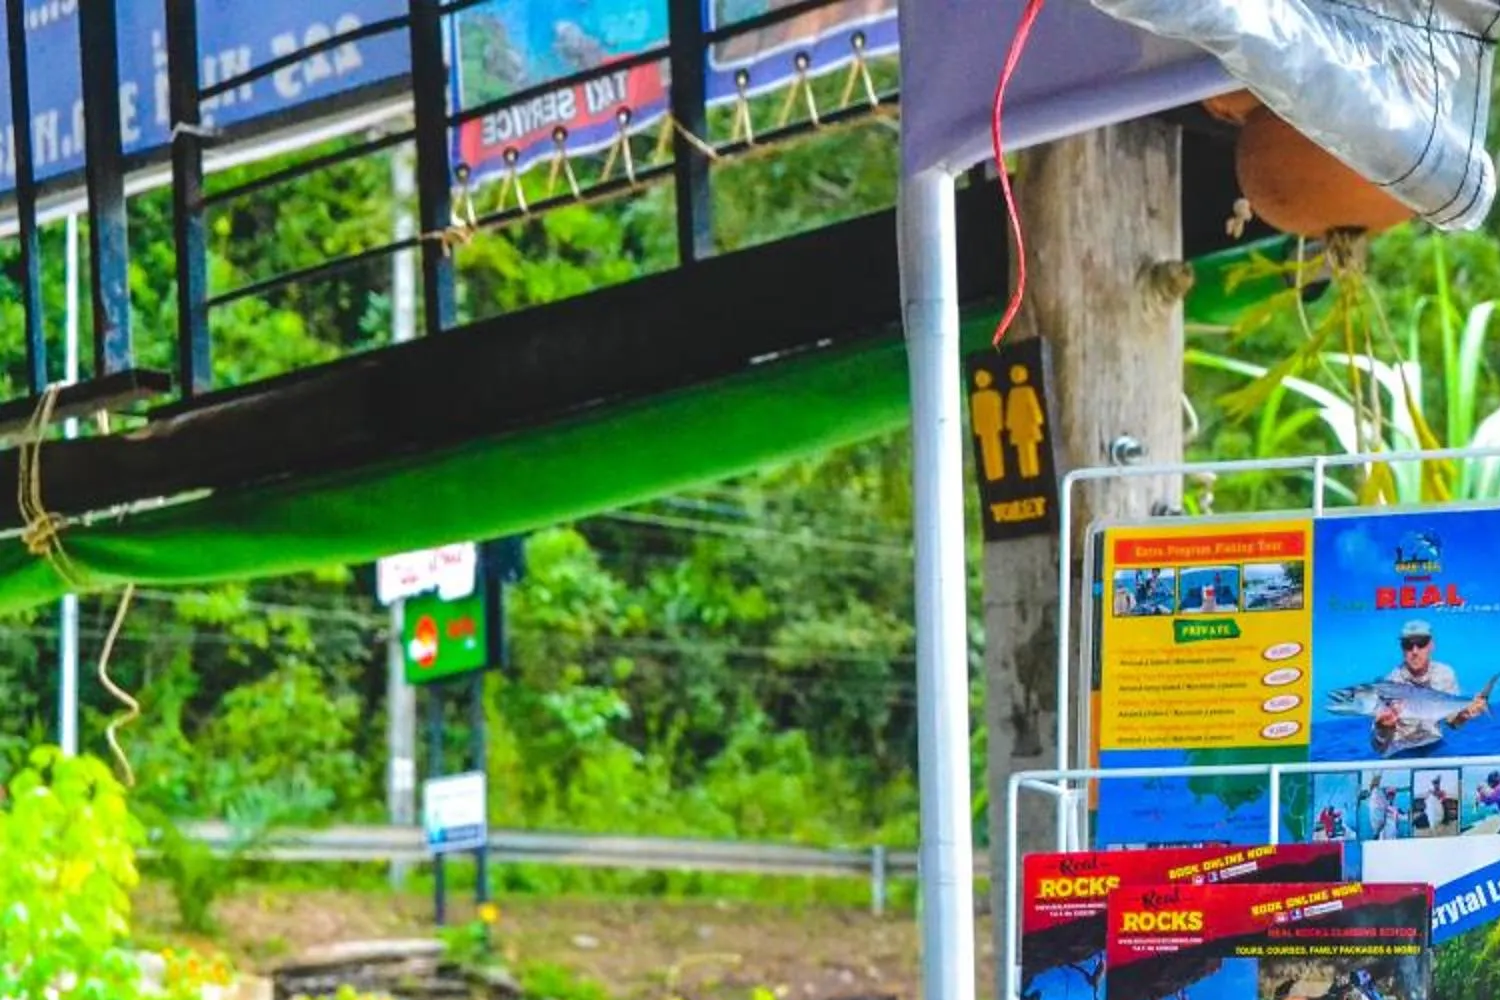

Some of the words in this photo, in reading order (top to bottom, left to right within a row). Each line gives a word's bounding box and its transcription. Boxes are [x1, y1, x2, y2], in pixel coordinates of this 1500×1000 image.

[1374, 583, 1465, 611] REAL
[1181, 623, 1231, 637] PRIVATE
[1168, 864, 1200, 880] BOOK
[1203, 853, 1245, 871] ONLINE
[1247, 844, 1277, 861] NOW!
[1251, 901, 1283, 917] BOOK
[1286, 891, 1329, 908] ONLINE
[1332, 882, 1363, 900] NOW!
[1120, 910, 1204, 932] ROCKS
[1309, 945, 1339, 954] FAMILY
[1340, 945, 1385, 954] PACKAGES
